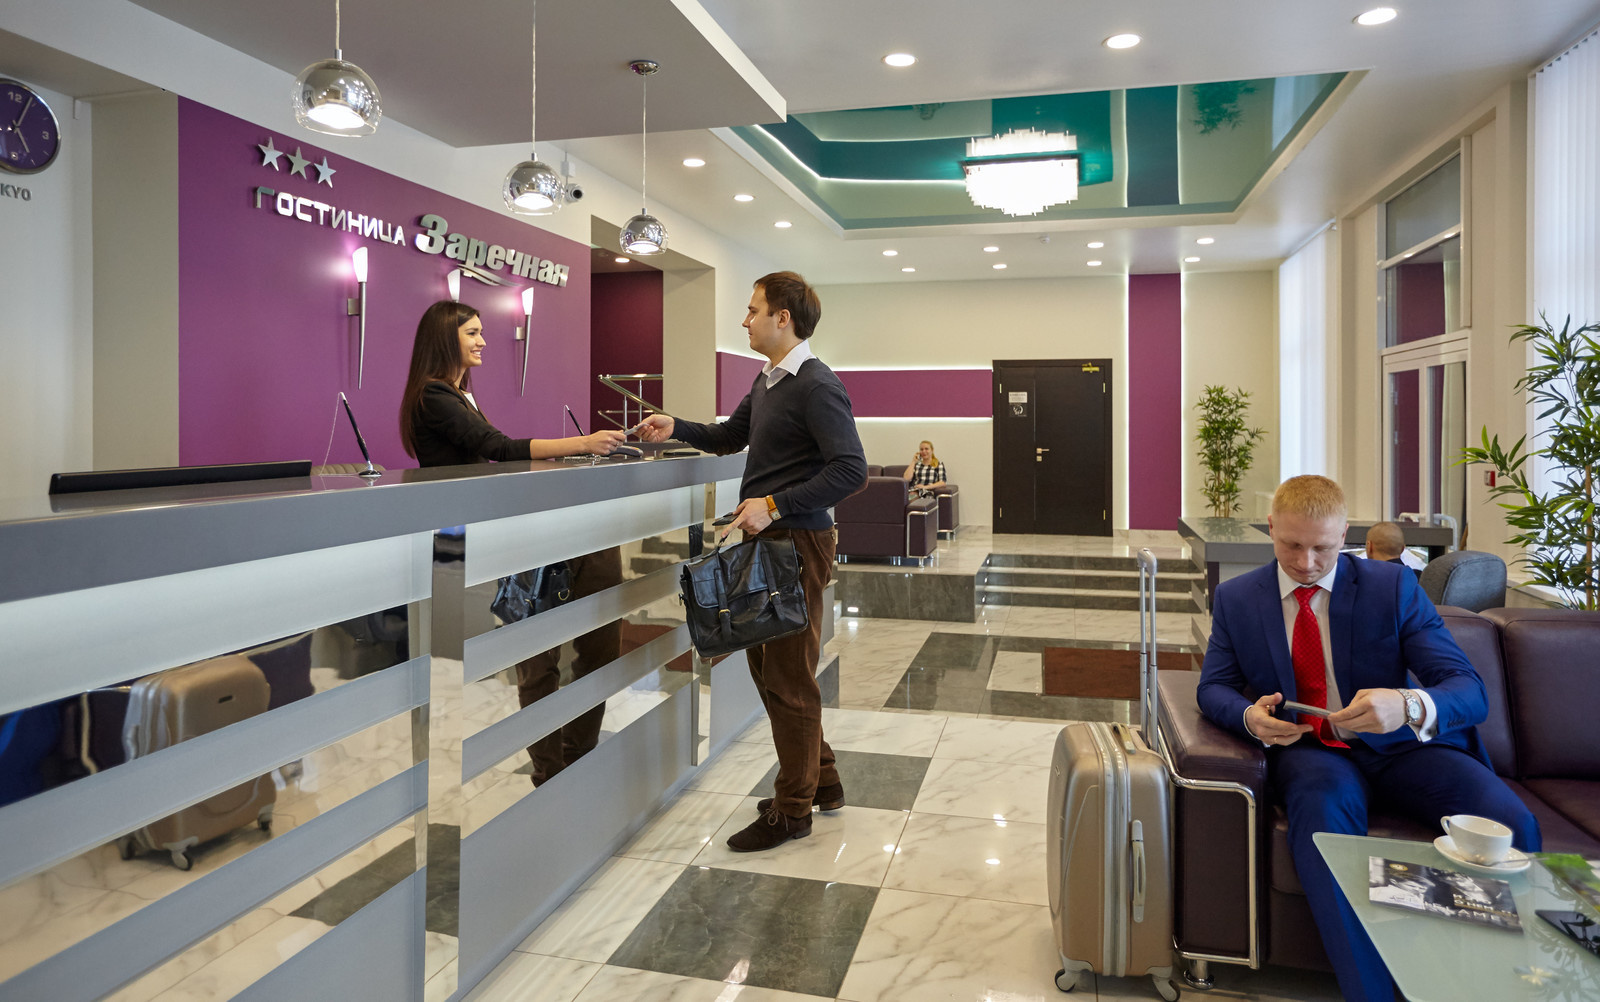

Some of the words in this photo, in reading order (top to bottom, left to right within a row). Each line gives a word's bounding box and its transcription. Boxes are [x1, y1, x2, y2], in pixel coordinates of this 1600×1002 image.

[8, 91, 22, 103] 12
[42, 130, 50, 140] 3
[256, 186, 406, 246] ГОСТИНИЦА
[415, 213, 570, 287] Заречная
